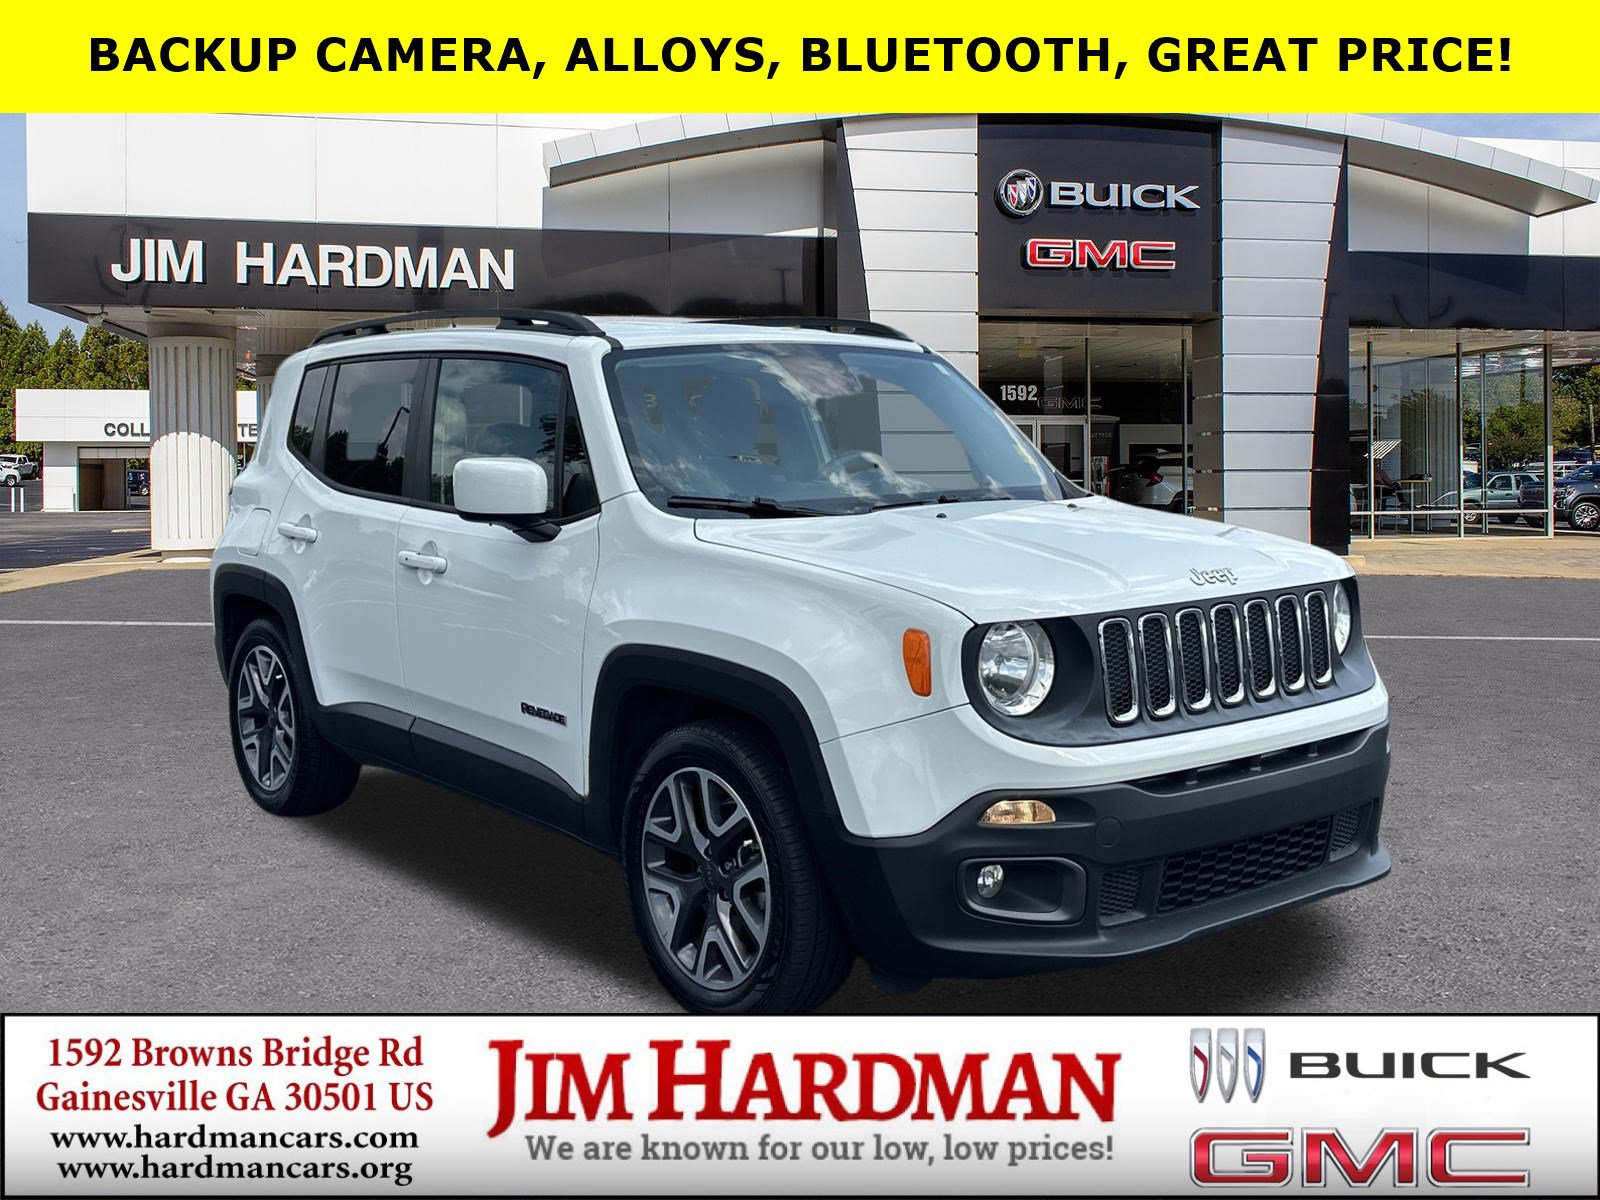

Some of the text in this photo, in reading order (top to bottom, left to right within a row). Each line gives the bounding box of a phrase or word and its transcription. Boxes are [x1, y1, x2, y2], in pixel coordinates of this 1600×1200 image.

[1050, 181, 1201, 209] BUICK
[110, 238, 515, 290] JIM HARDMAN
[1025, 238, 1177, 270] GMC
[1000, 385, 1038, 401] 1592
[1188, 566, 1238, 586] Jeep
